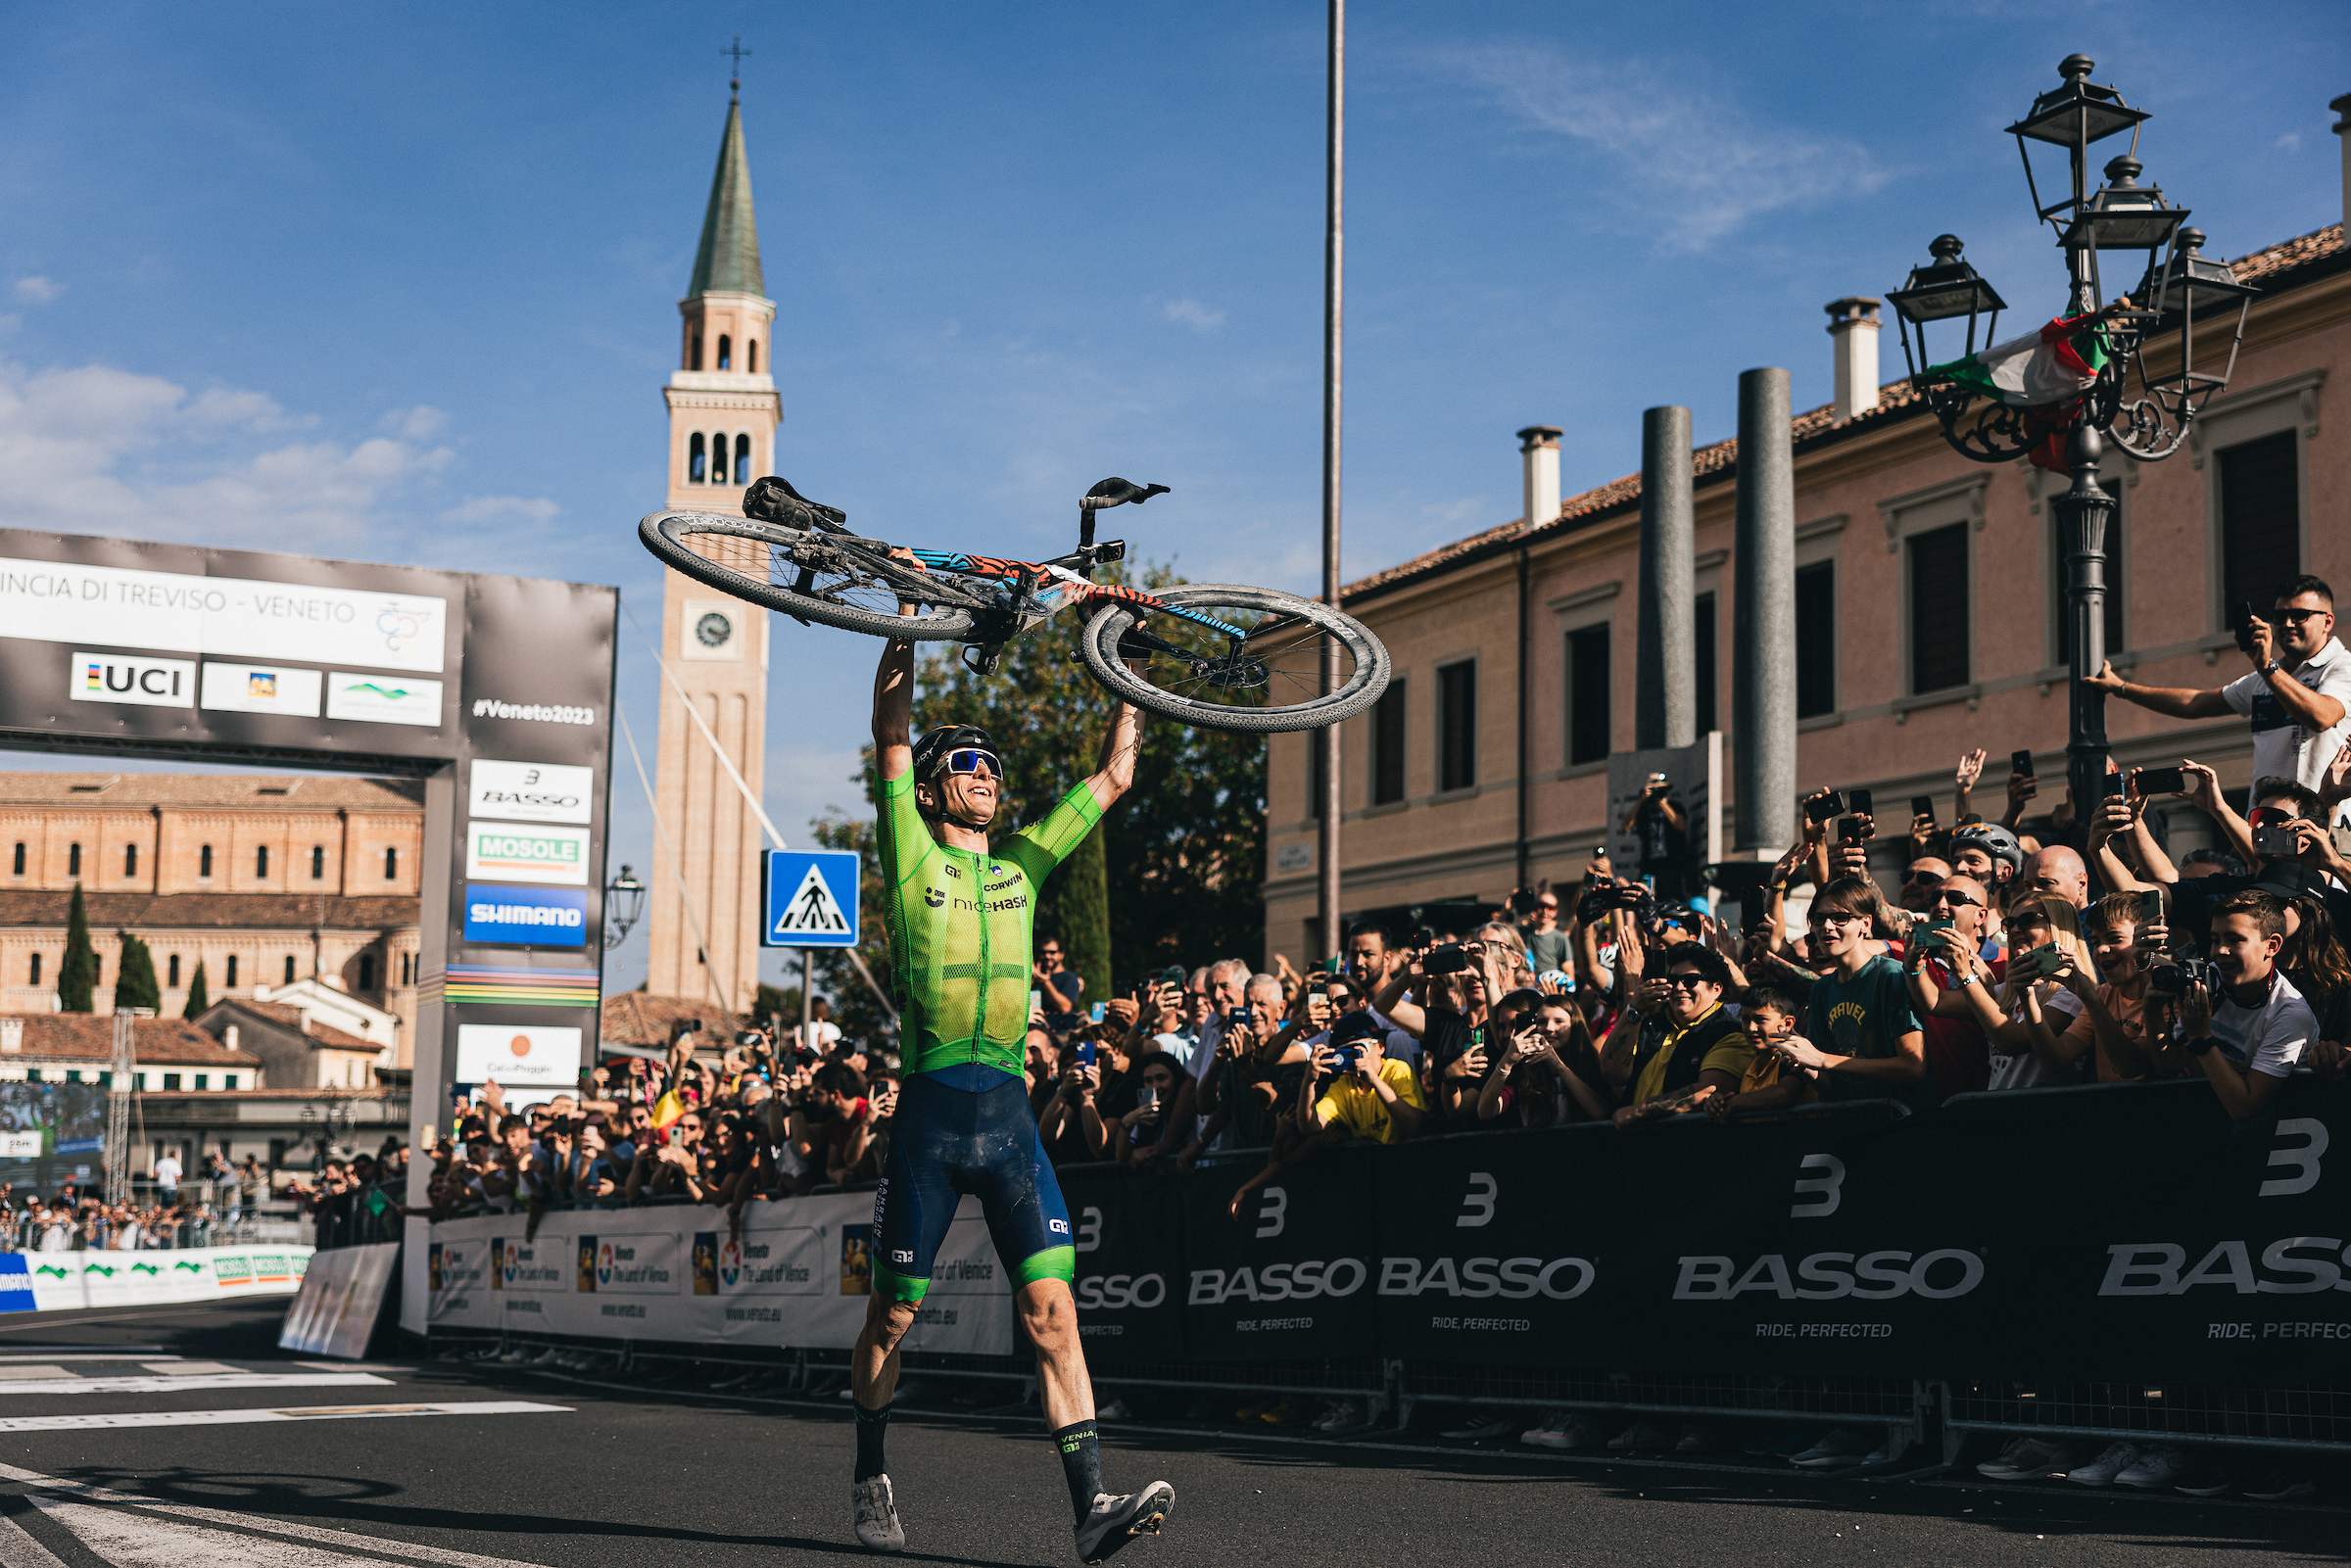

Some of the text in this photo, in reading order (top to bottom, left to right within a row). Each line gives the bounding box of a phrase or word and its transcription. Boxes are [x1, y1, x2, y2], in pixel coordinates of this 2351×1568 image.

[81, 578, 108, 601] DI
[118, 581, 226, 612] TREVISO
[253, 594, 356, 624] VENETO
[105, 665, 181, 697] UCI
[472, 699, 595, 726] #Veneto2023
[914, 747, 934, 767] UDY
[482, 790, 580, 809] BASSO
[481, 836, 577, 861] MOSOLE
[984, 872, 1023, 892] CORWIN
[470, 903, 582, 927] SHIMANO
[877, 1178, 889, 1238] BAHRAIN
[785, 1263, 810, 1283] Venice
[945, 1259, 958, 1280] of
[958, 1259, 994, 1280] Venice
[1672, 1248, 1985, 1300] BASSO
[2097, 1236, 2351, 1296] BAS
[1071, 1272, 1166, 1309] SSO
[1188, 1258, 1367, 1306] BASSO
[1377, 1257, 1596, 1301] BASSO
[913, 1307, 958, 1325] eneto.eu
[1236, 1316, 1314, 1332] RIDE, PERFECTED
[1432, 1316, 1530, 1332] RIDE, PERFECTED
[1755, 1323, 1893, 1340] RIDE, PERFECTED
[2208, 1323, 2256, 1342] RIDE,
